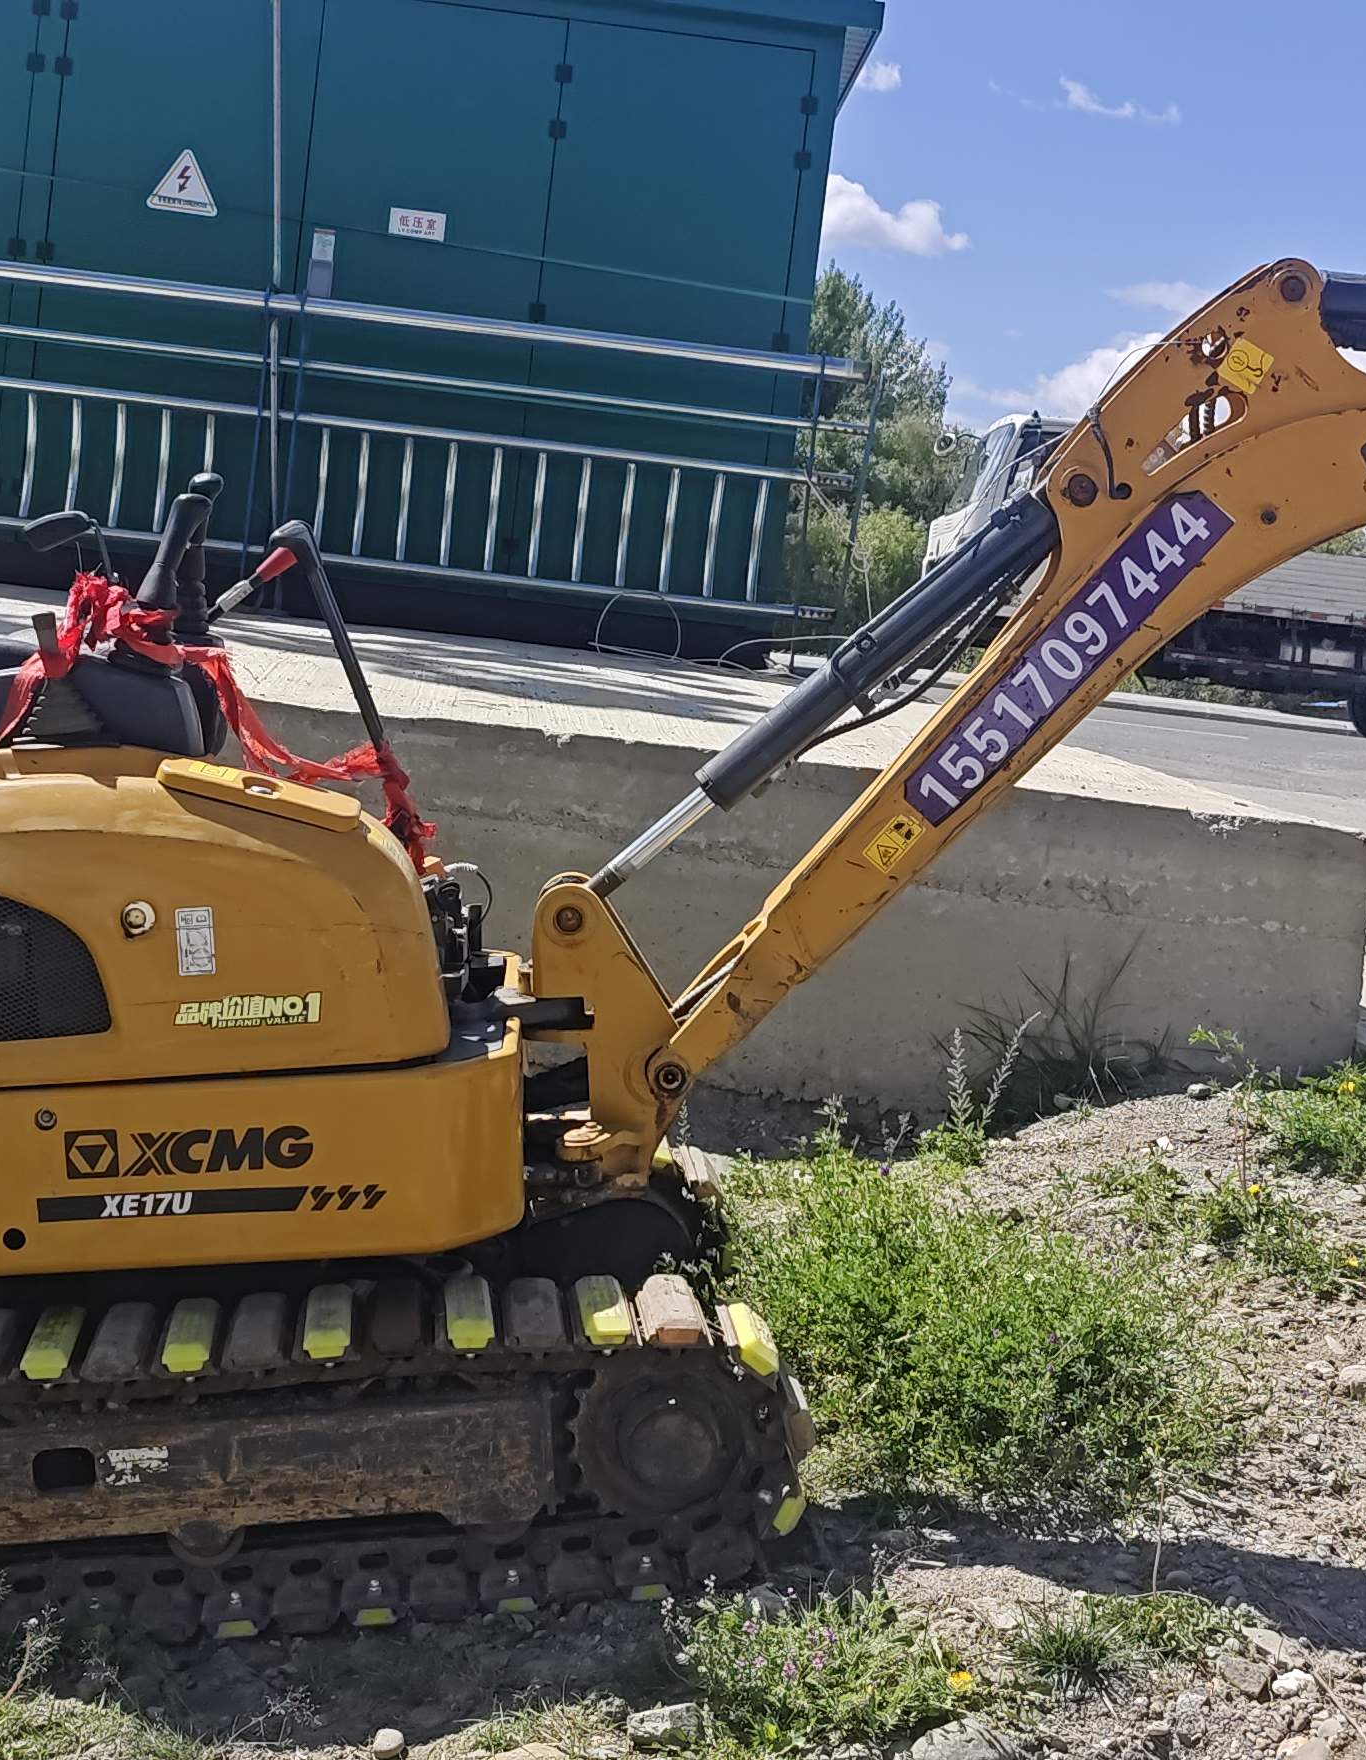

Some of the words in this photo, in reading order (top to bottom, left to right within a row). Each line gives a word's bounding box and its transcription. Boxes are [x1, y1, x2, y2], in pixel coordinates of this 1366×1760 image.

[399, 214, 437, 231] 低压室
[919, 501, 1211, 810] 15517097444
[218, 1018, 261, 1029] BRAND
[266, 1015, 306, 1026] VALUE
[121, 1125, 314, 1177] XCMG
[99, 1191, 193, 1218] XE17U
